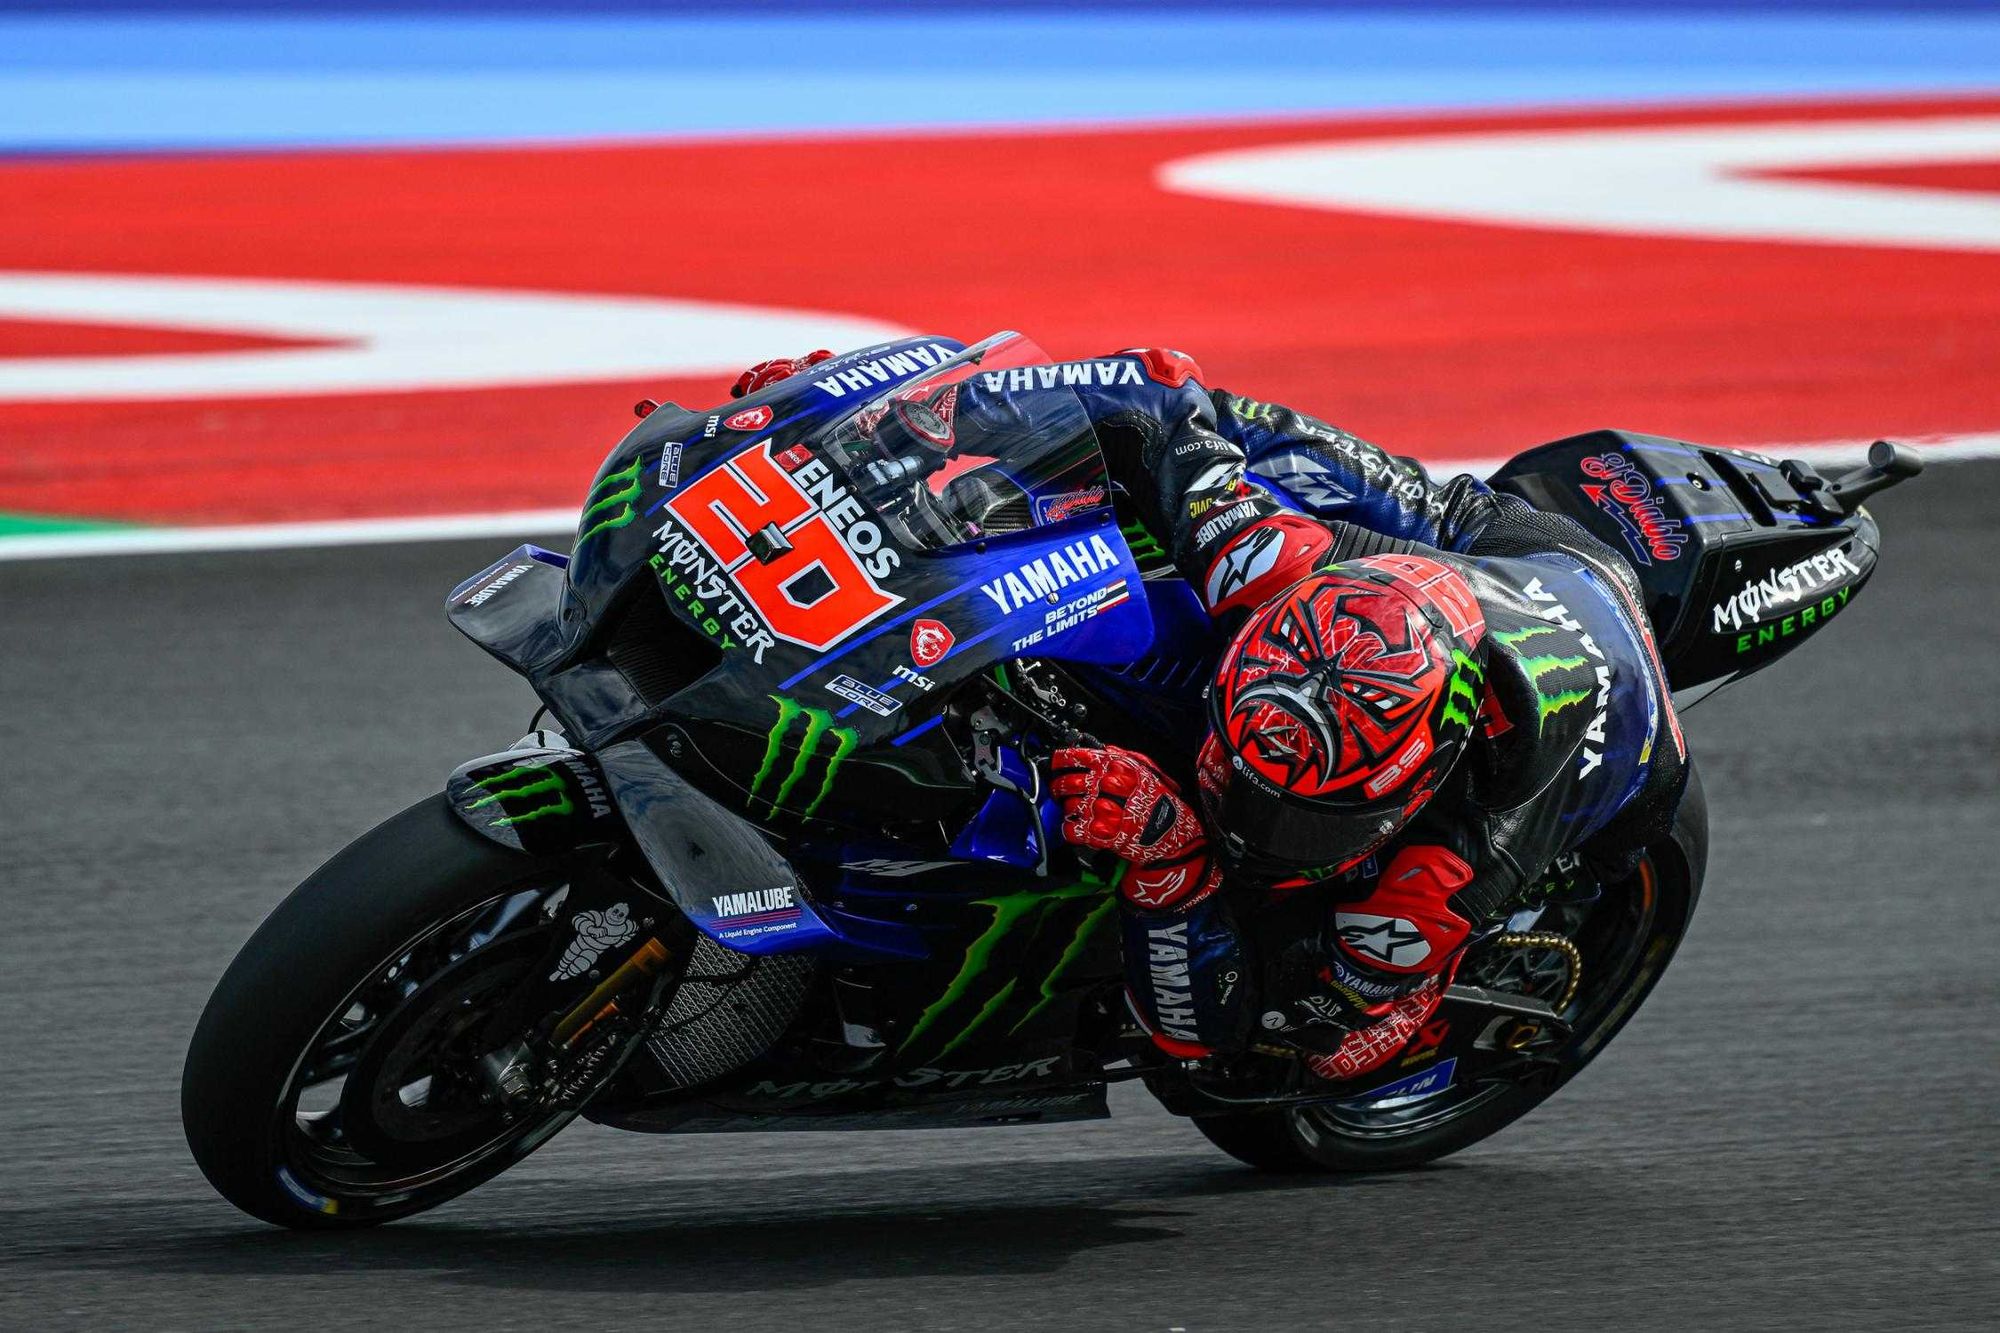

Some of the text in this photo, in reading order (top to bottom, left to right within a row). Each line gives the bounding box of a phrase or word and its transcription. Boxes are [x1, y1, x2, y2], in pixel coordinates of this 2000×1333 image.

[813, 344, 958, 398] YAMAHA
[983, 361, 1145, 393] YAMAHA
[704, 415, 720, 438] msi
[791, 457, 902, 580] ENEOS
[1196, 501, 1261, 550] YAMALUBE
[663, 437, 907, 652] 20
[464, 564, 534, 608] YAMALUBE
[981, 534, 1120, 615] YAMAHA
[648, 554, 737, 652] ENERGY
[1045, 586, 1107, 625] BEYOND
[1736, 586, 1850, 655] ENERGY
[1012, 604, 1098, 652] THE LIMITS
[833, 686, 885, 712] CORE
[842, 678, 895, 706] BLUE
[892, 664, 936, 692] msi
[1523, 576, 1611, 781] YAMAHA
[712, 886, 794, 918] YAMALUBE
[725, 930, 743, 938] Liquid
[743, 927, 763, 936] Engine
[763, 922, 797, 933] Component
[1148, 921, 1200, 1042] YAMAHA
